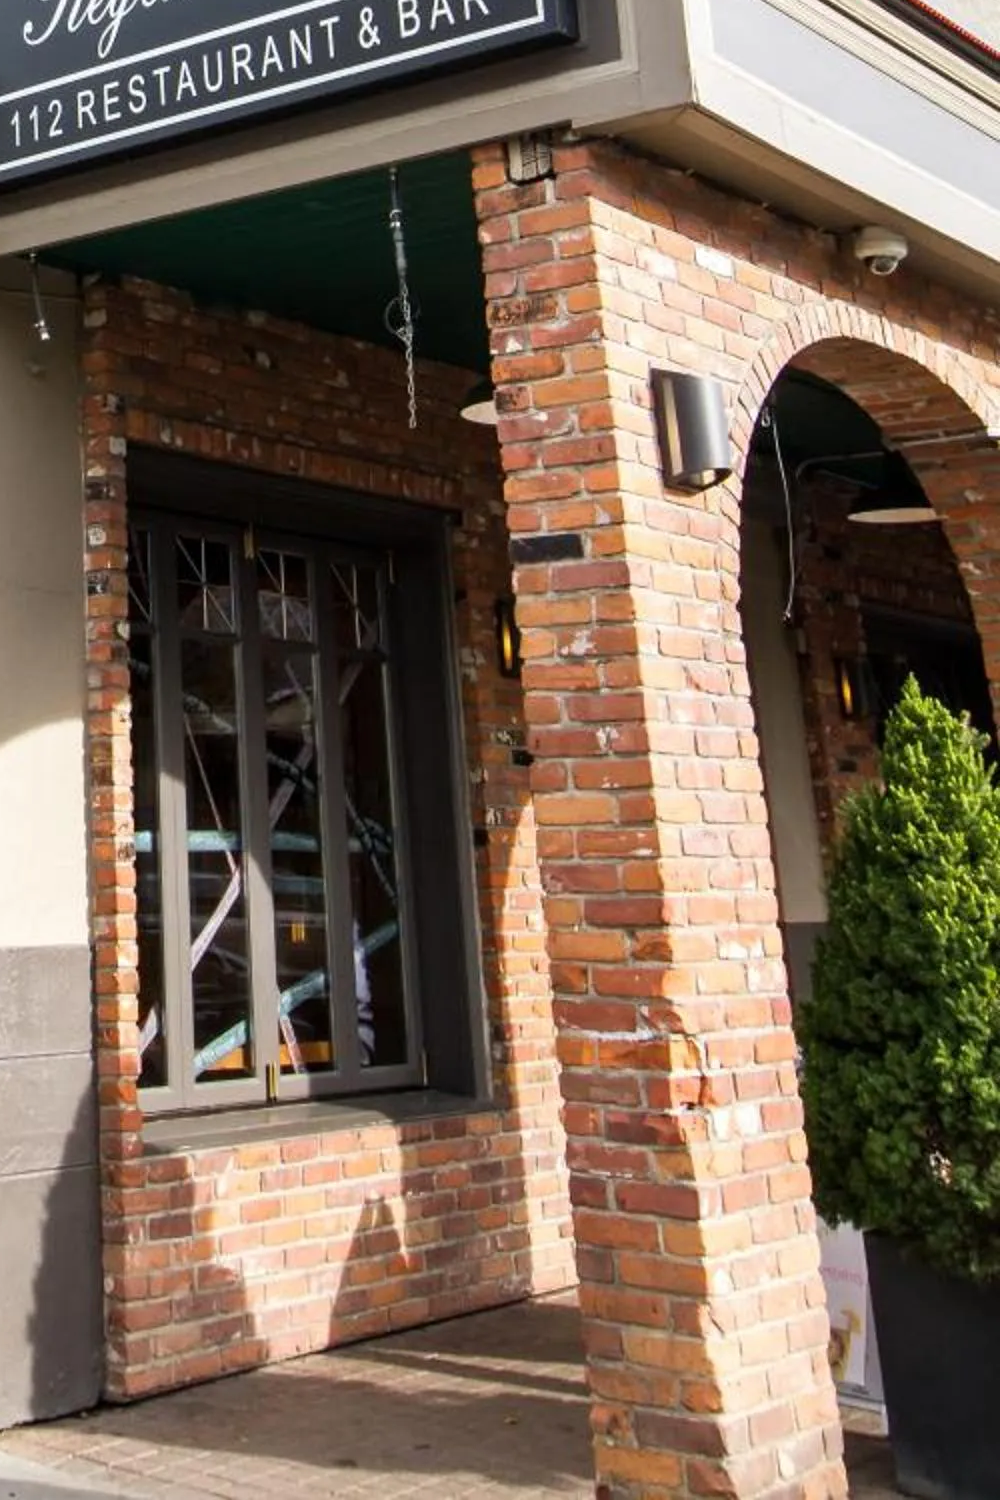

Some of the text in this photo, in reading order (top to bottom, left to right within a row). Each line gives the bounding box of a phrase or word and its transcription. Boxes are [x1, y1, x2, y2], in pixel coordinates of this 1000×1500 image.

[10, 100, 64, 147] 112
[76, 16, 342, 129] RESTAURANT
[358, 6, 382, 50] &
